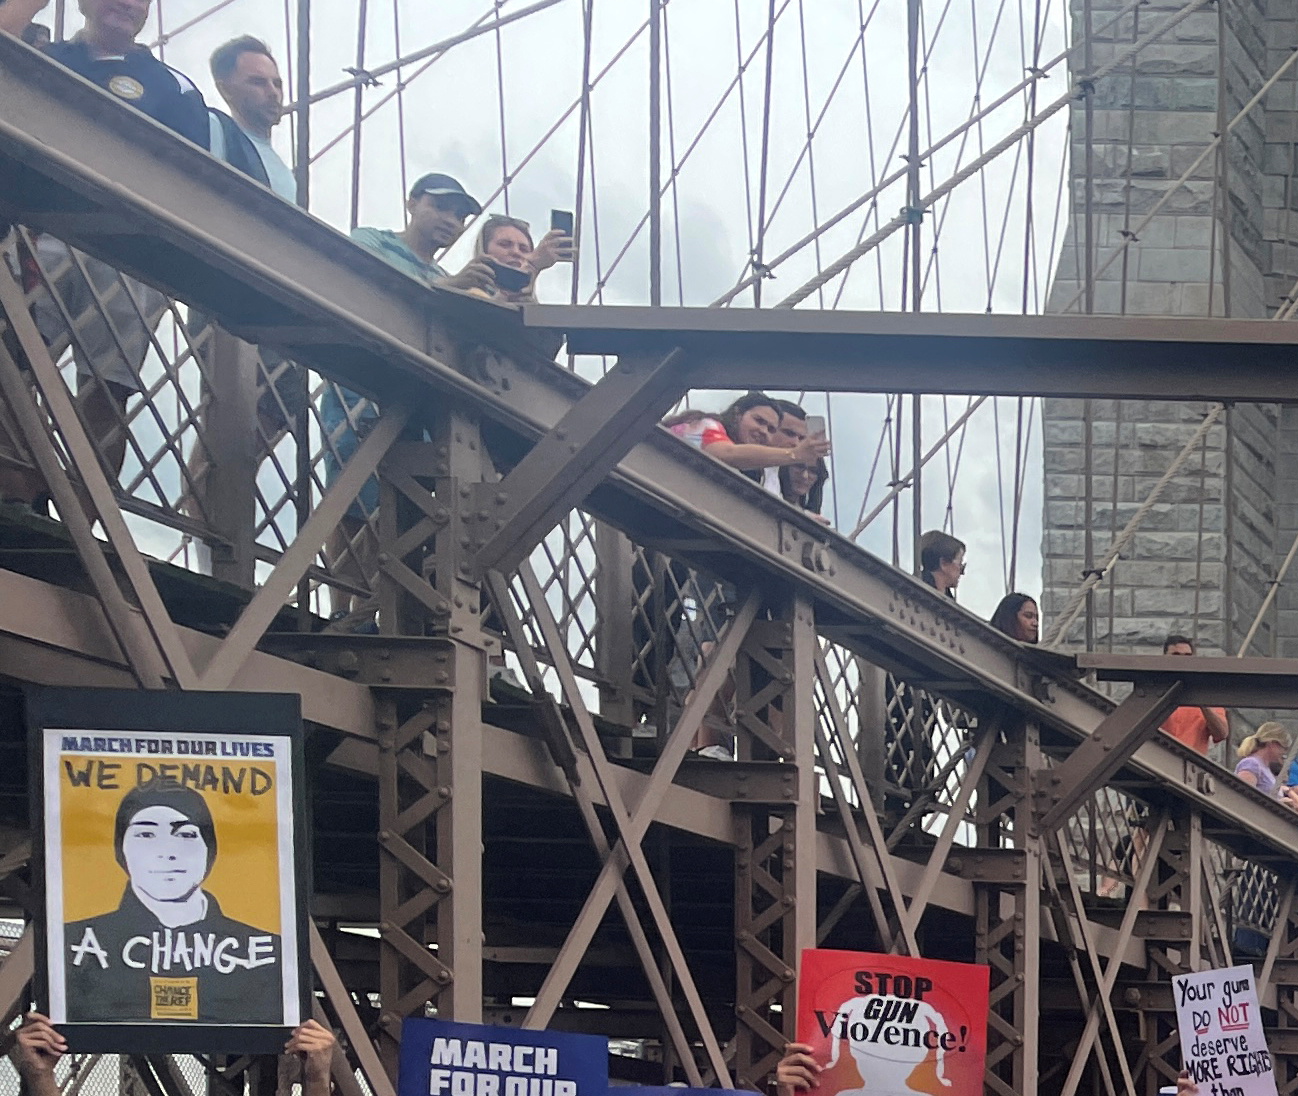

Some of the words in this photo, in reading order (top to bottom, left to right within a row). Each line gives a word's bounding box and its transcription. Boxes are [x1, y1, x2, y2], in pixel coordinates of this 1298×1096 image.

[62, 737, 132, 752] MARCH
[135, 739, 174, 754] FOR
[177, 740, 217, 755] OUR
[221, 741, 275, 757] LIVES
[65, 760, 121, 789] WE
[137, 763, 272, 795] DEMAND
[70, 927, 109, 969] A
[122, 928, 275, 974] CHANGE
[854, 971, 932, 1000] STOP
[1177, 979, 1215, 1007] Your
[864, 998, 919, 1024] GUN
[1193, 1010, 1211, 1030] DO
[1218, 1002, 1249, 1024] NOT
[814, 1010, 968, 1053] Violence!
[1191, 1034, 1248, 1057] deserve
[430, 1037, 558, 1075] MARCH
[1186, 1057, 1222, 1084] MORE
